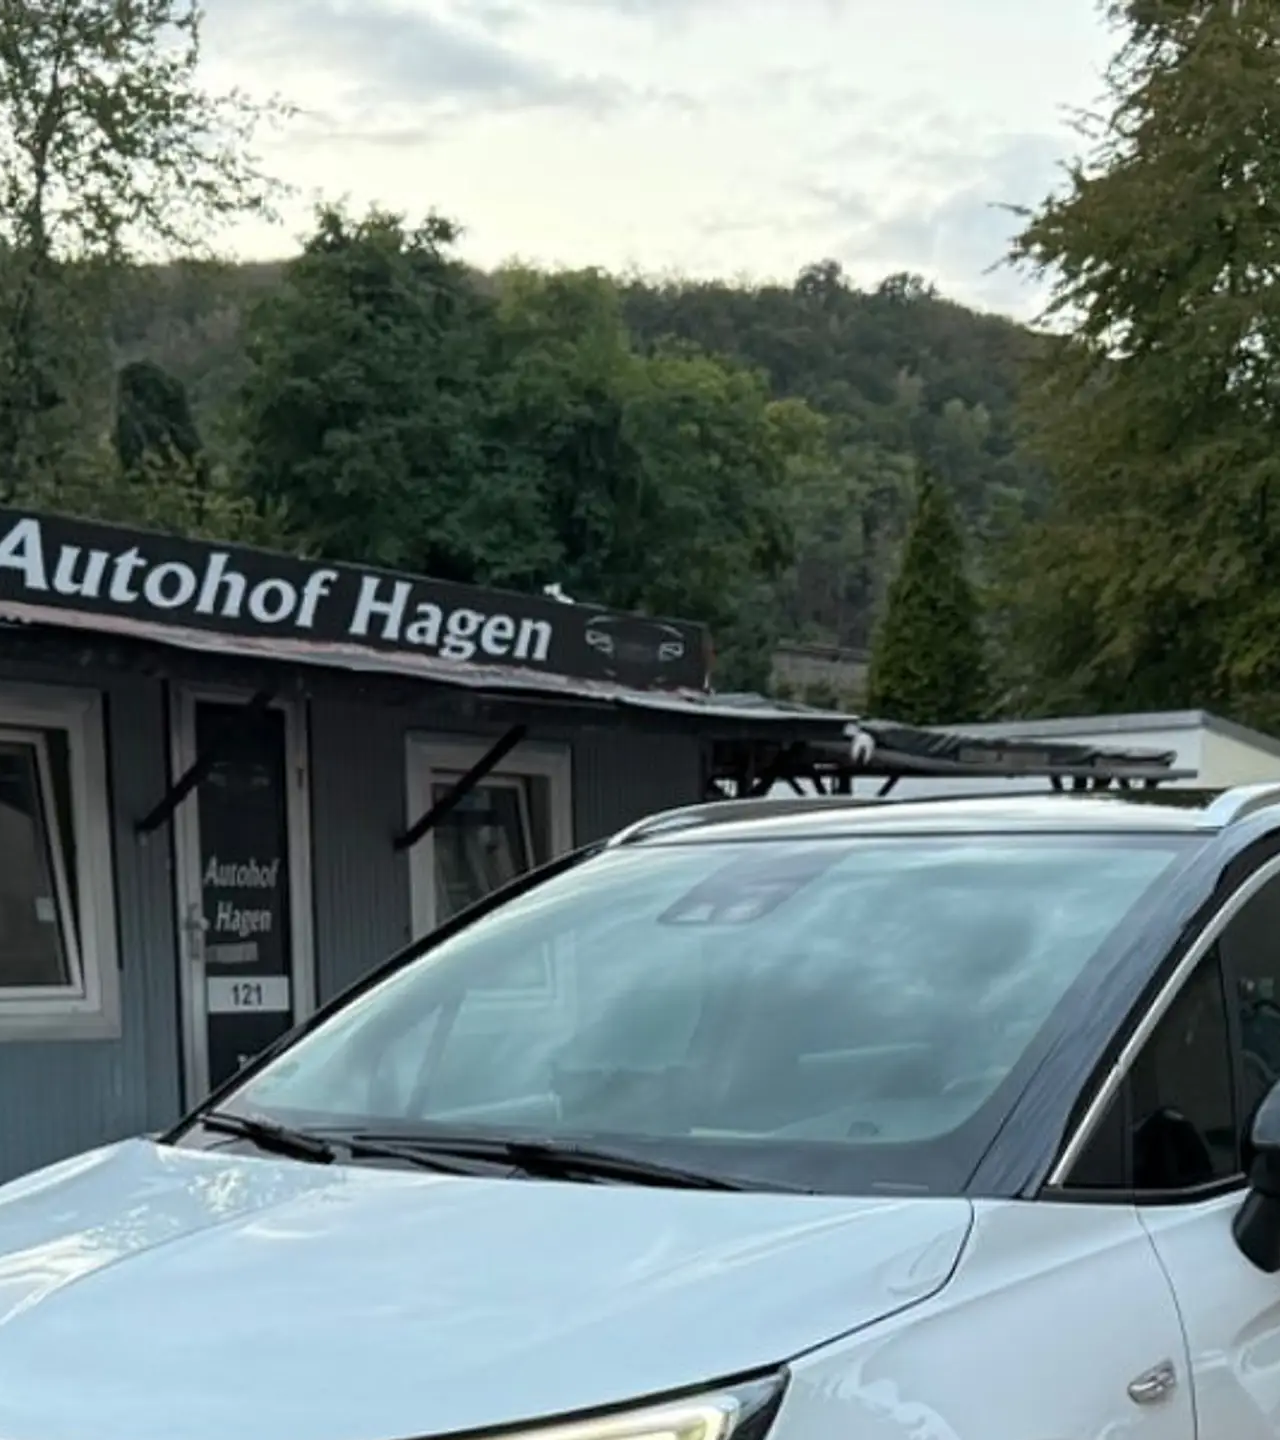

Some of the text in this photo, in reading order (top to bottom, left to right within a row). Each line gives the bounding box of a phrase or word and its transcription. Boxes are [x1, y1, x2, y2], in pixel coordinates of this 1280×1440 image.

[348, 575, 553, 662] Hagen
[203, 856, 280, 888] Autohof
[215, 901, 272, 937] Hagen
[232, 983, 262, 1006] 121
